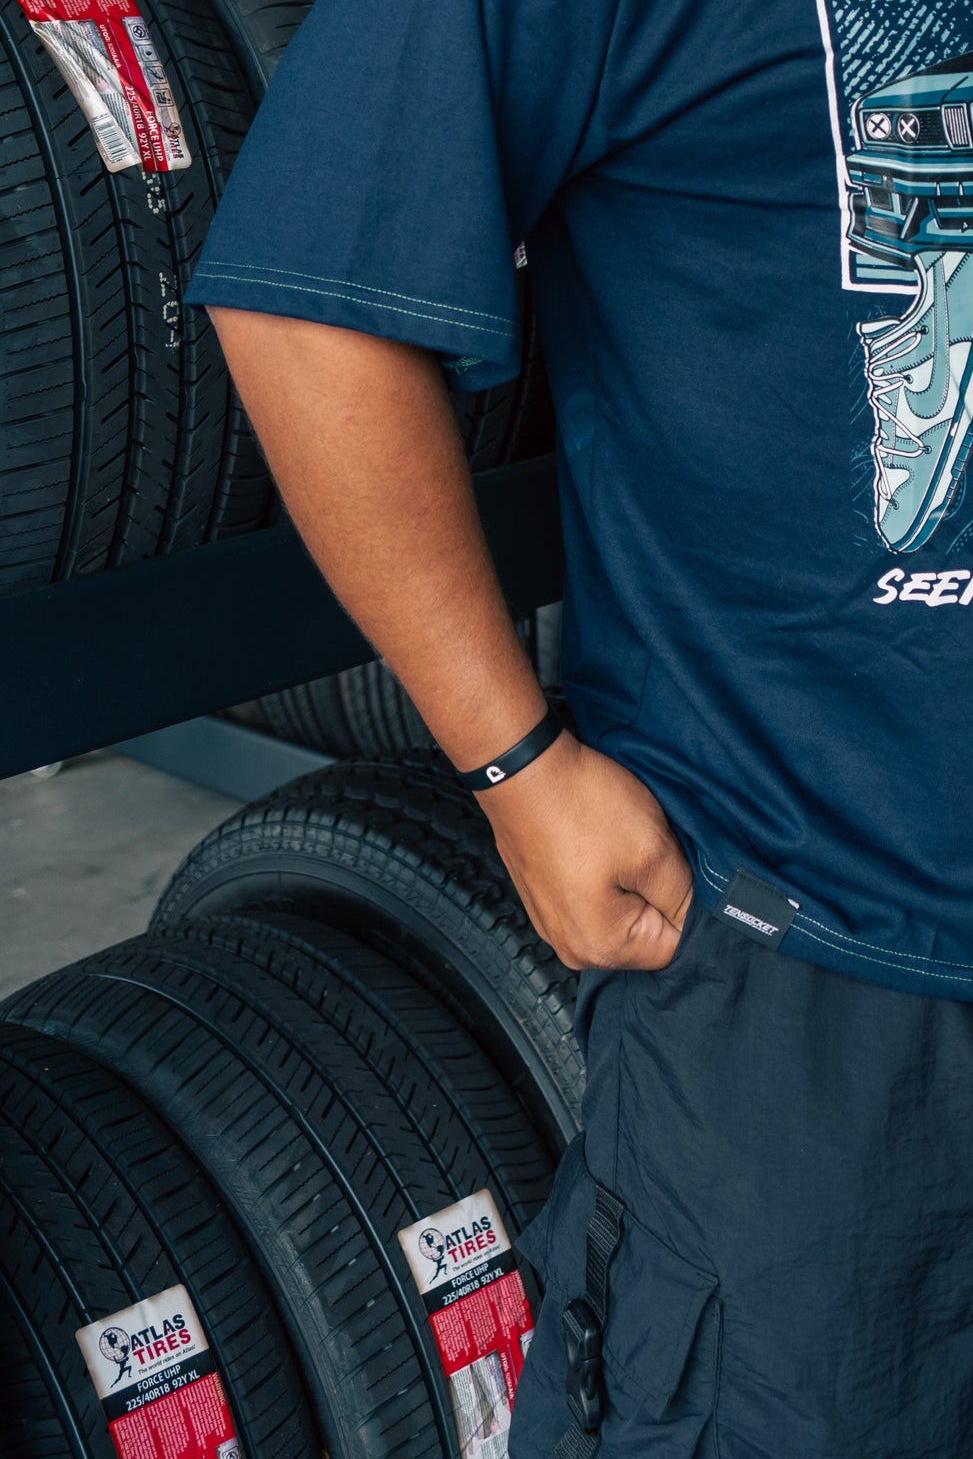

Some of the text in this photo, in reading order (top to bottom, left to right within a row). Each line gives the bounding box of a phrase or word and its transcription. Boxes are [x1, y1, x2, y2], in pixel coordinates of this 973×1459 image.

[138, 132, 149, 151] 92Y
[146, 110, 160, 141] FORCE
[153, 141, 164, 162] UHP
[142, 151, 151, 162] XL
[724, 904, 779, 934] TENSOCKET
[445, 1216, 491, 1250] ATLAS
[447, 1230, 497, 1263] TIRES
[442, 1267, 504, 1306] 225/40R18 92Y XL
[451, 1263, 489, 1288] FORCE UHP
[131, 1313, 186, 1351] ATLAS
[133, 1328, 191, 1365] TIRES
[137, 1364, 181, 1392] FORCE UHP
[148, 1361, 162, 1371] world
[162, 1355, 175, 1364] rides
[125, 1369, 201, 1411] 225/40R18 92Y XL
